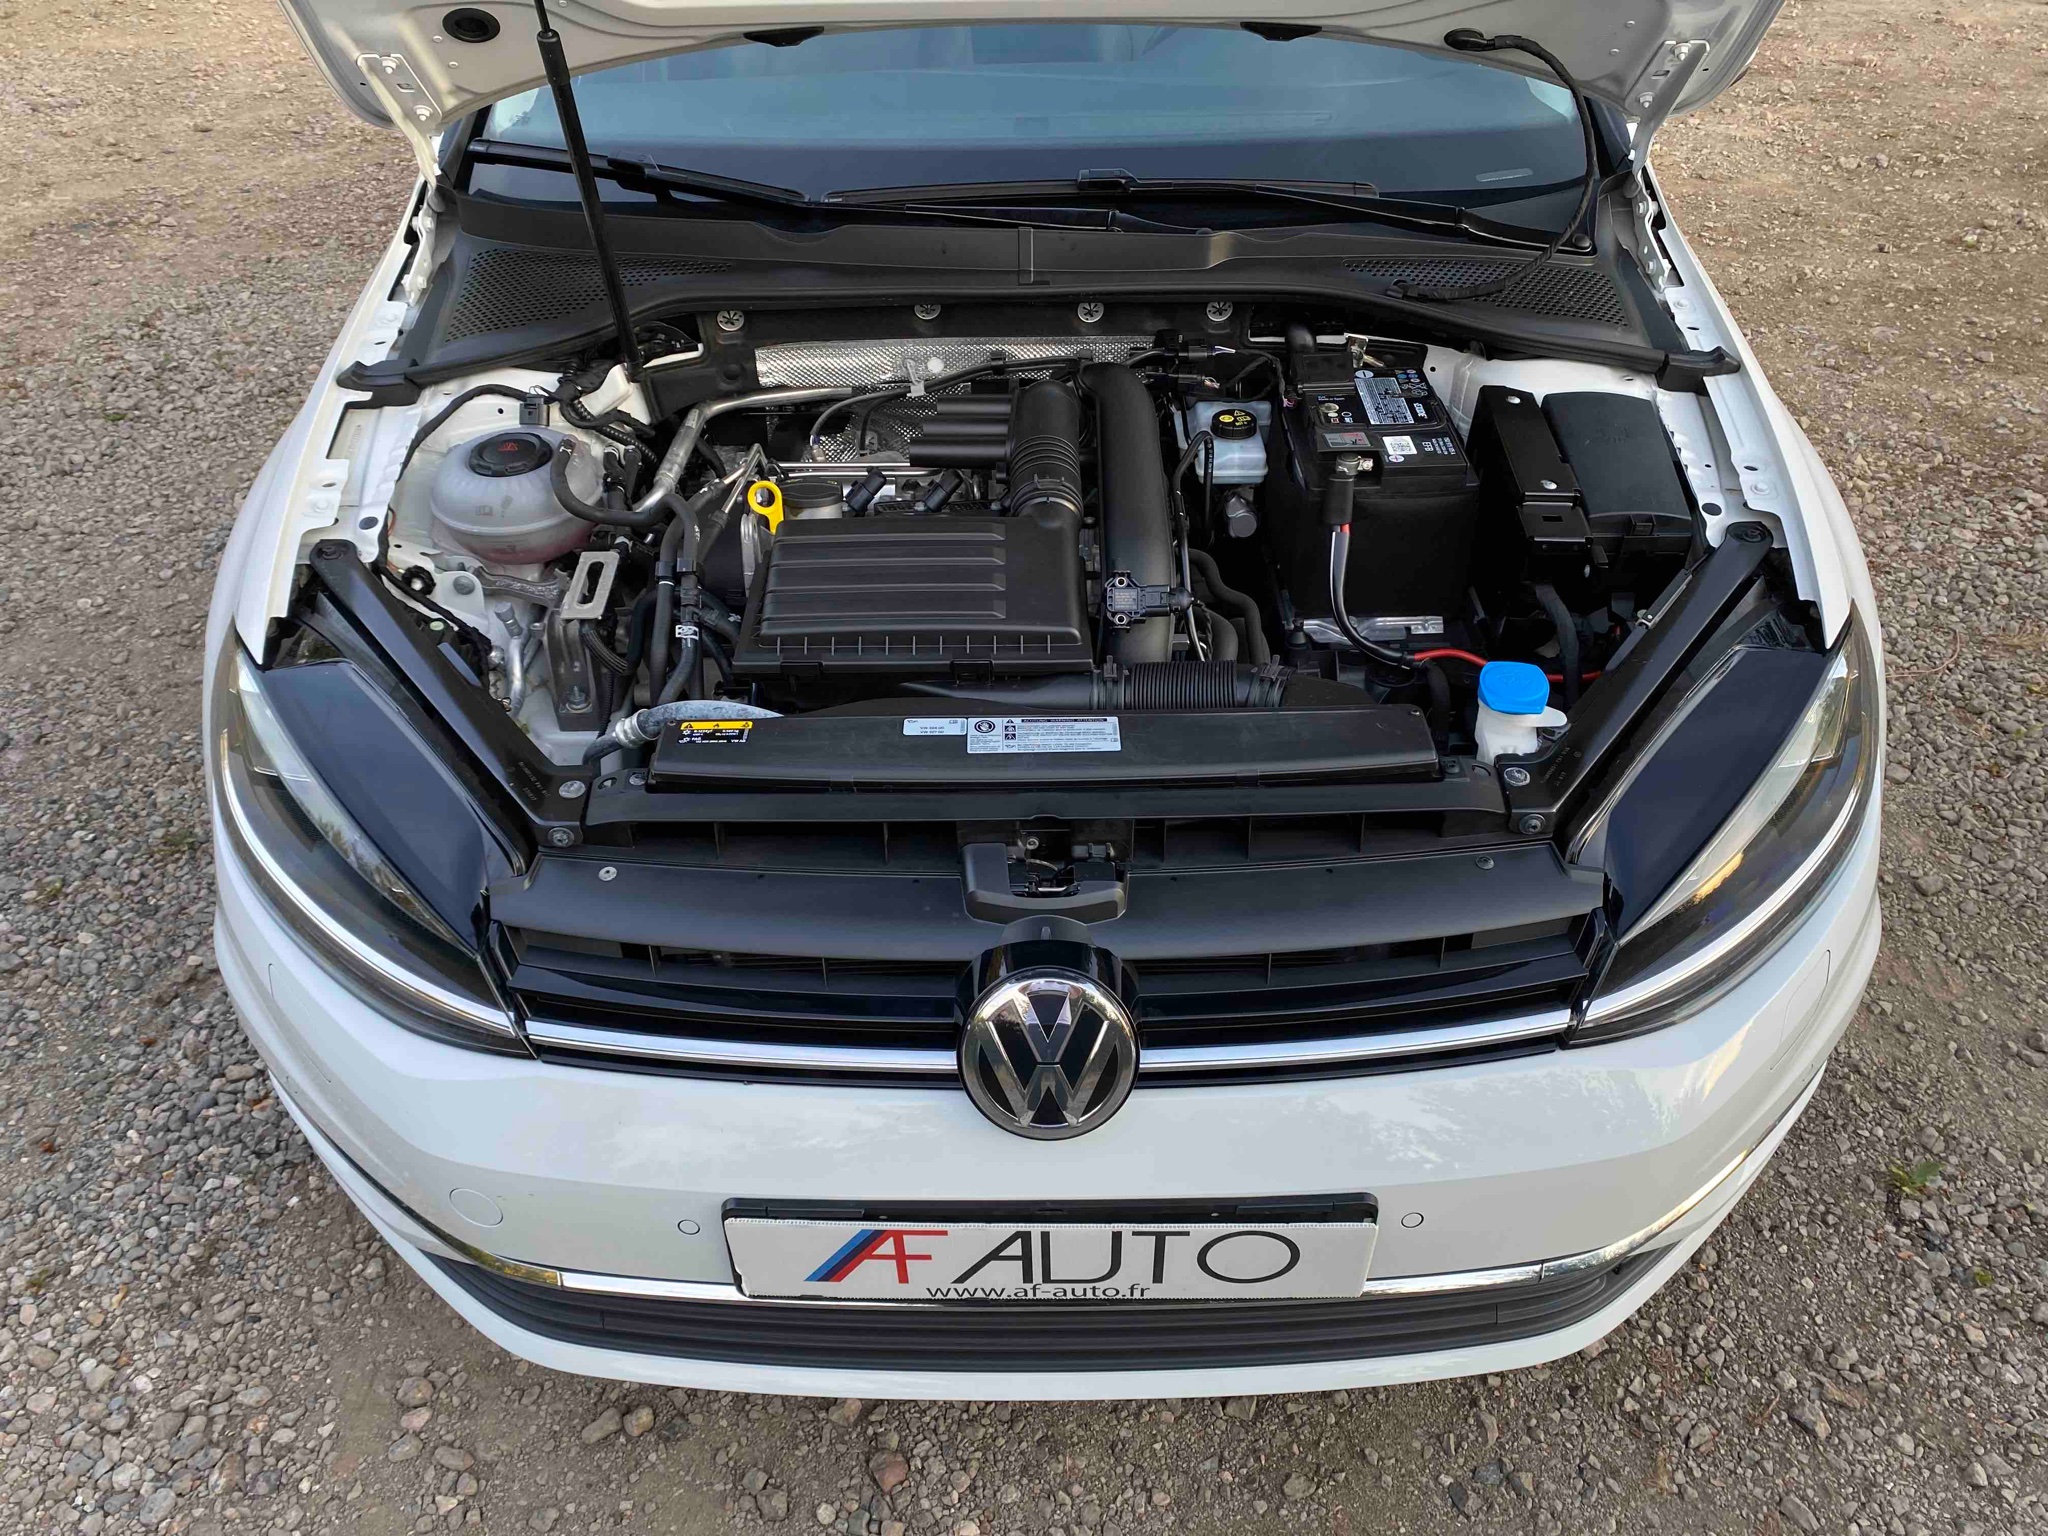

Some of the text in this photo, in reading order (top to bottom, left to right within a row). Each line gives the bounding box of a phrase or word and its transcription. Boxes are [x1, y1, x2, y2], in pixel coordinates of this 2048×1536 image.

[804, 1228, 1301, 1284] AF AUTO
[926, 1283, 1151, 1298] www.af-auto.fr
